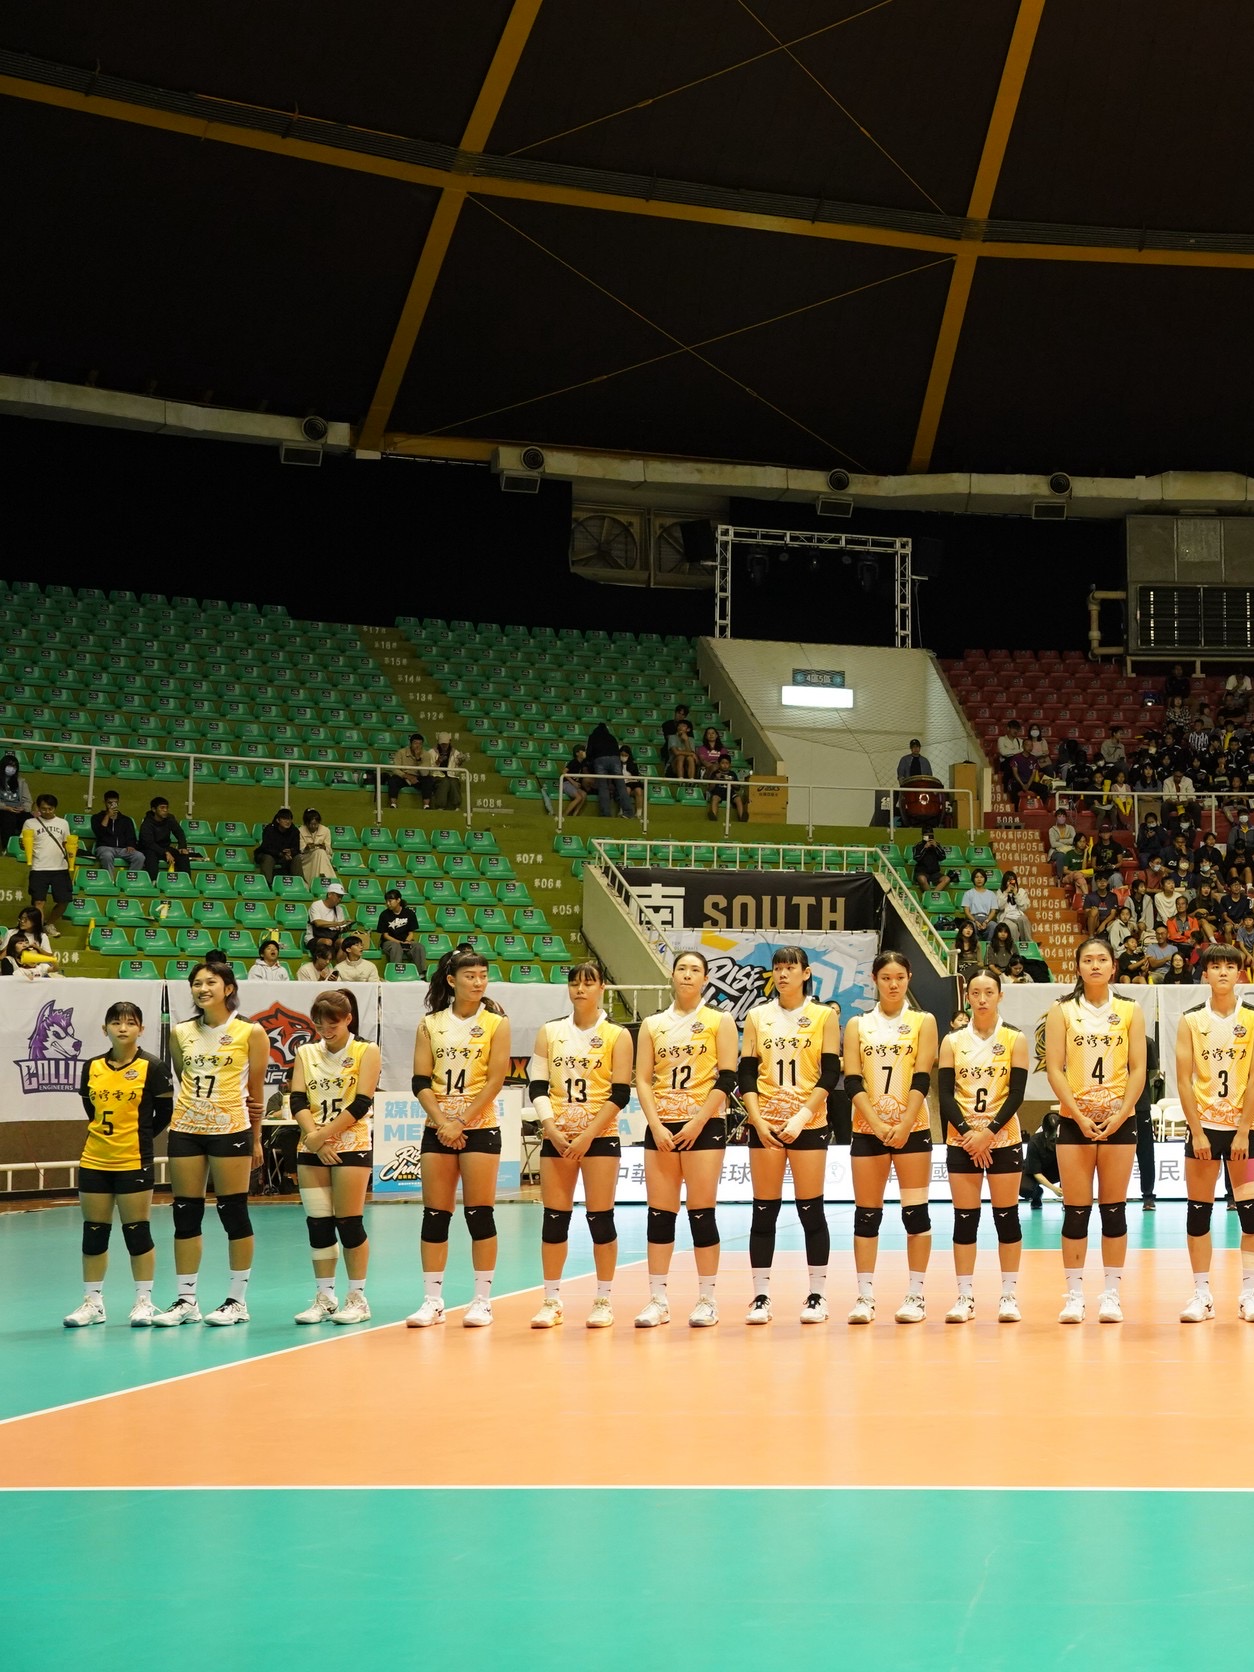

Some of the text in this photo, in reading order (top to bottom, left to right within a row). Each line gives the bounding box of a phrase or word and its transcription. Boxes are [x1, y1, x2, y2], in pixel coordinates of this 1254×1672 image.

[631, 883, 685, 929] 南
[703, 894, 846, 931] SOUTH
[657, 1044, 708, 1058] 台灣電力
[762, 1037, 812, 1051] 台灣電力
[863, 1044, 914, 1057] 台灣電力
[1073, 1034, 1123, 1048] 台灣電力
[184, 1054, 233, 1067] 台灣電力
[435, 1046, 483, 1060] 台灣電力
[553, 1056, 602, 1069] 台灣電力
[1200, 1048, 1247, 1061] 台灣電力
[445, 1069, 466, 1095] 14
[671, 1066, 691, 1090] 12
[776, 1059, 796, 1086] 11
[881, 1066, 893, 1095] 7
[959, 1065, 1008, 1079] 台灣電力
[1091, 1056, 1105, 1085] 4
[193, 1075, 216, 1098] 17
[308, 1076, 357, 1091] 台灣電力
[565, 1078, 588, 1103] 13
[1217, 1070, 1229, 1098] 3
[89, 1089, 137, 1103] 台灣電力
[976, 1088, 989, 1113] 6
[320, 1098, 345, 1123] 15
[102, 1111, 114, 1136] 5
